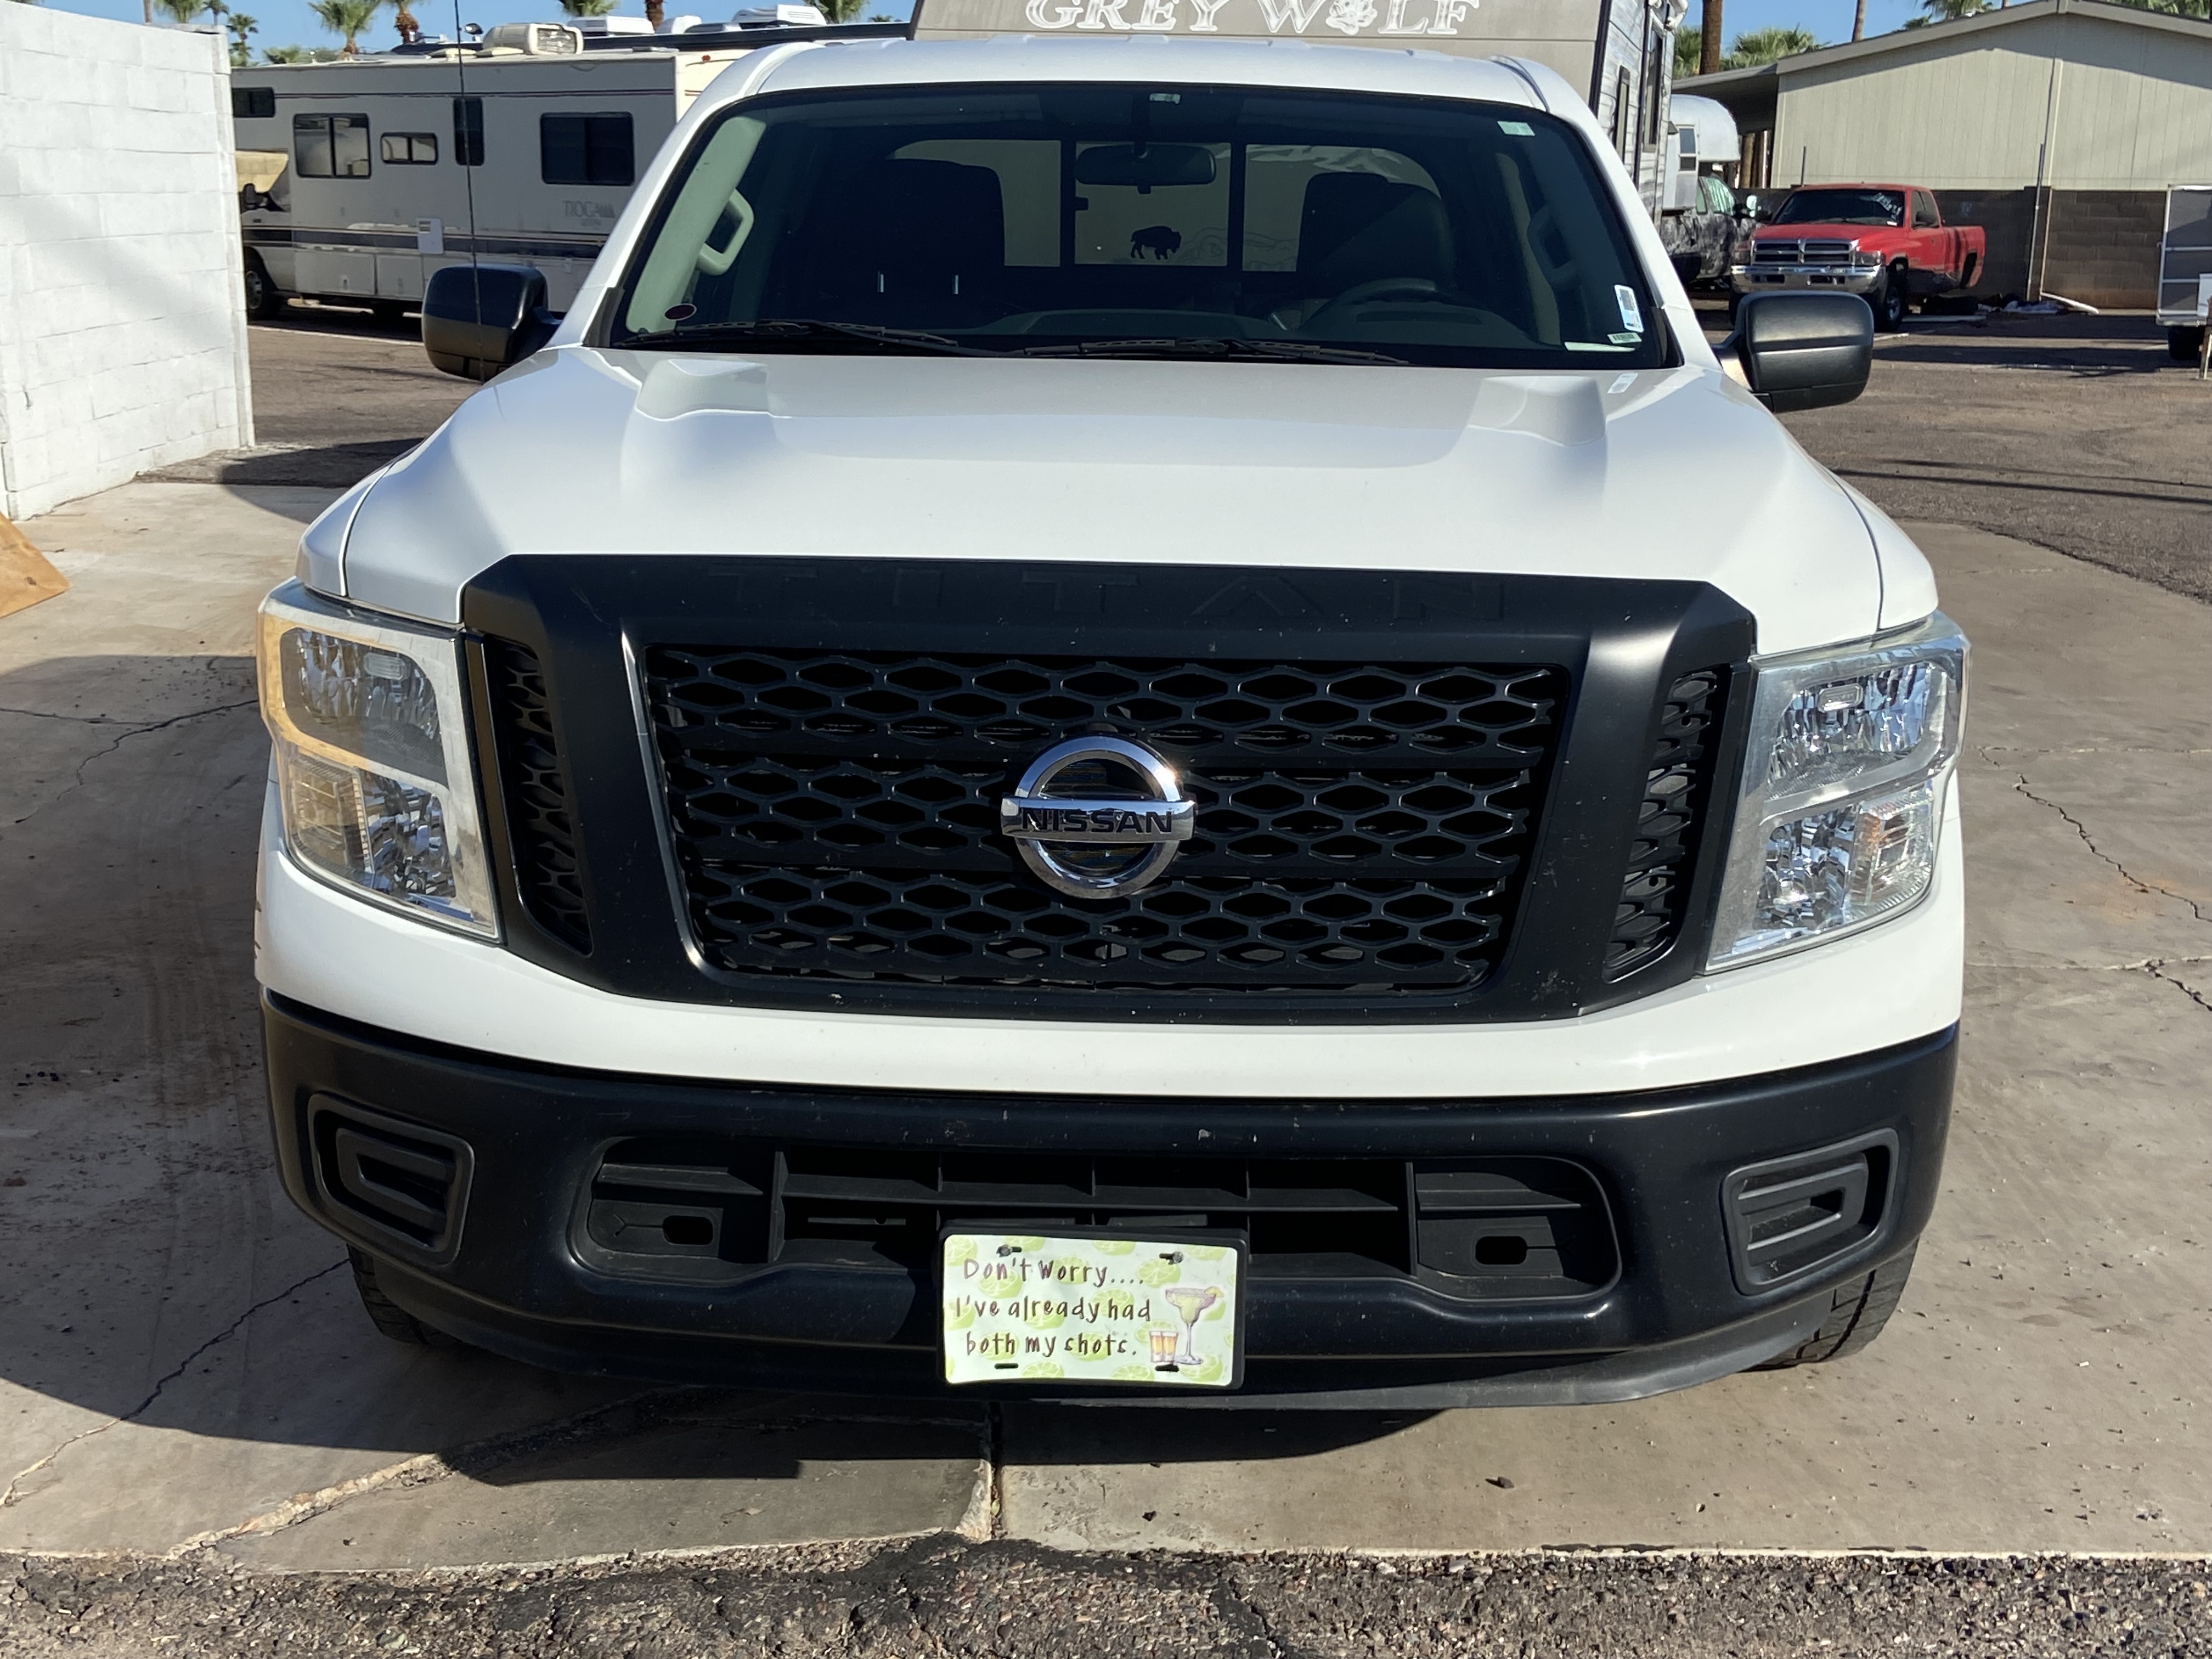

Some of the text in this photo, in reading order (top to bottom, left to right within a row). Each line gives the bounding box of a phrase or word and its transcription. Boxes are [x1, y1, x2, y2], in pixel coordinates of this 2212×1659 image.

[1025, 0, 1230, 31] GREY
[707, 565, 1505, 622] TITAN
[1021, 808, 1172, 834] NISSAN
[963, 1257, 1031, 1282] Don't
[956, 1295, 1151, 1323] I've already had
[966, 1331, 1137, 1357] both my shots.
